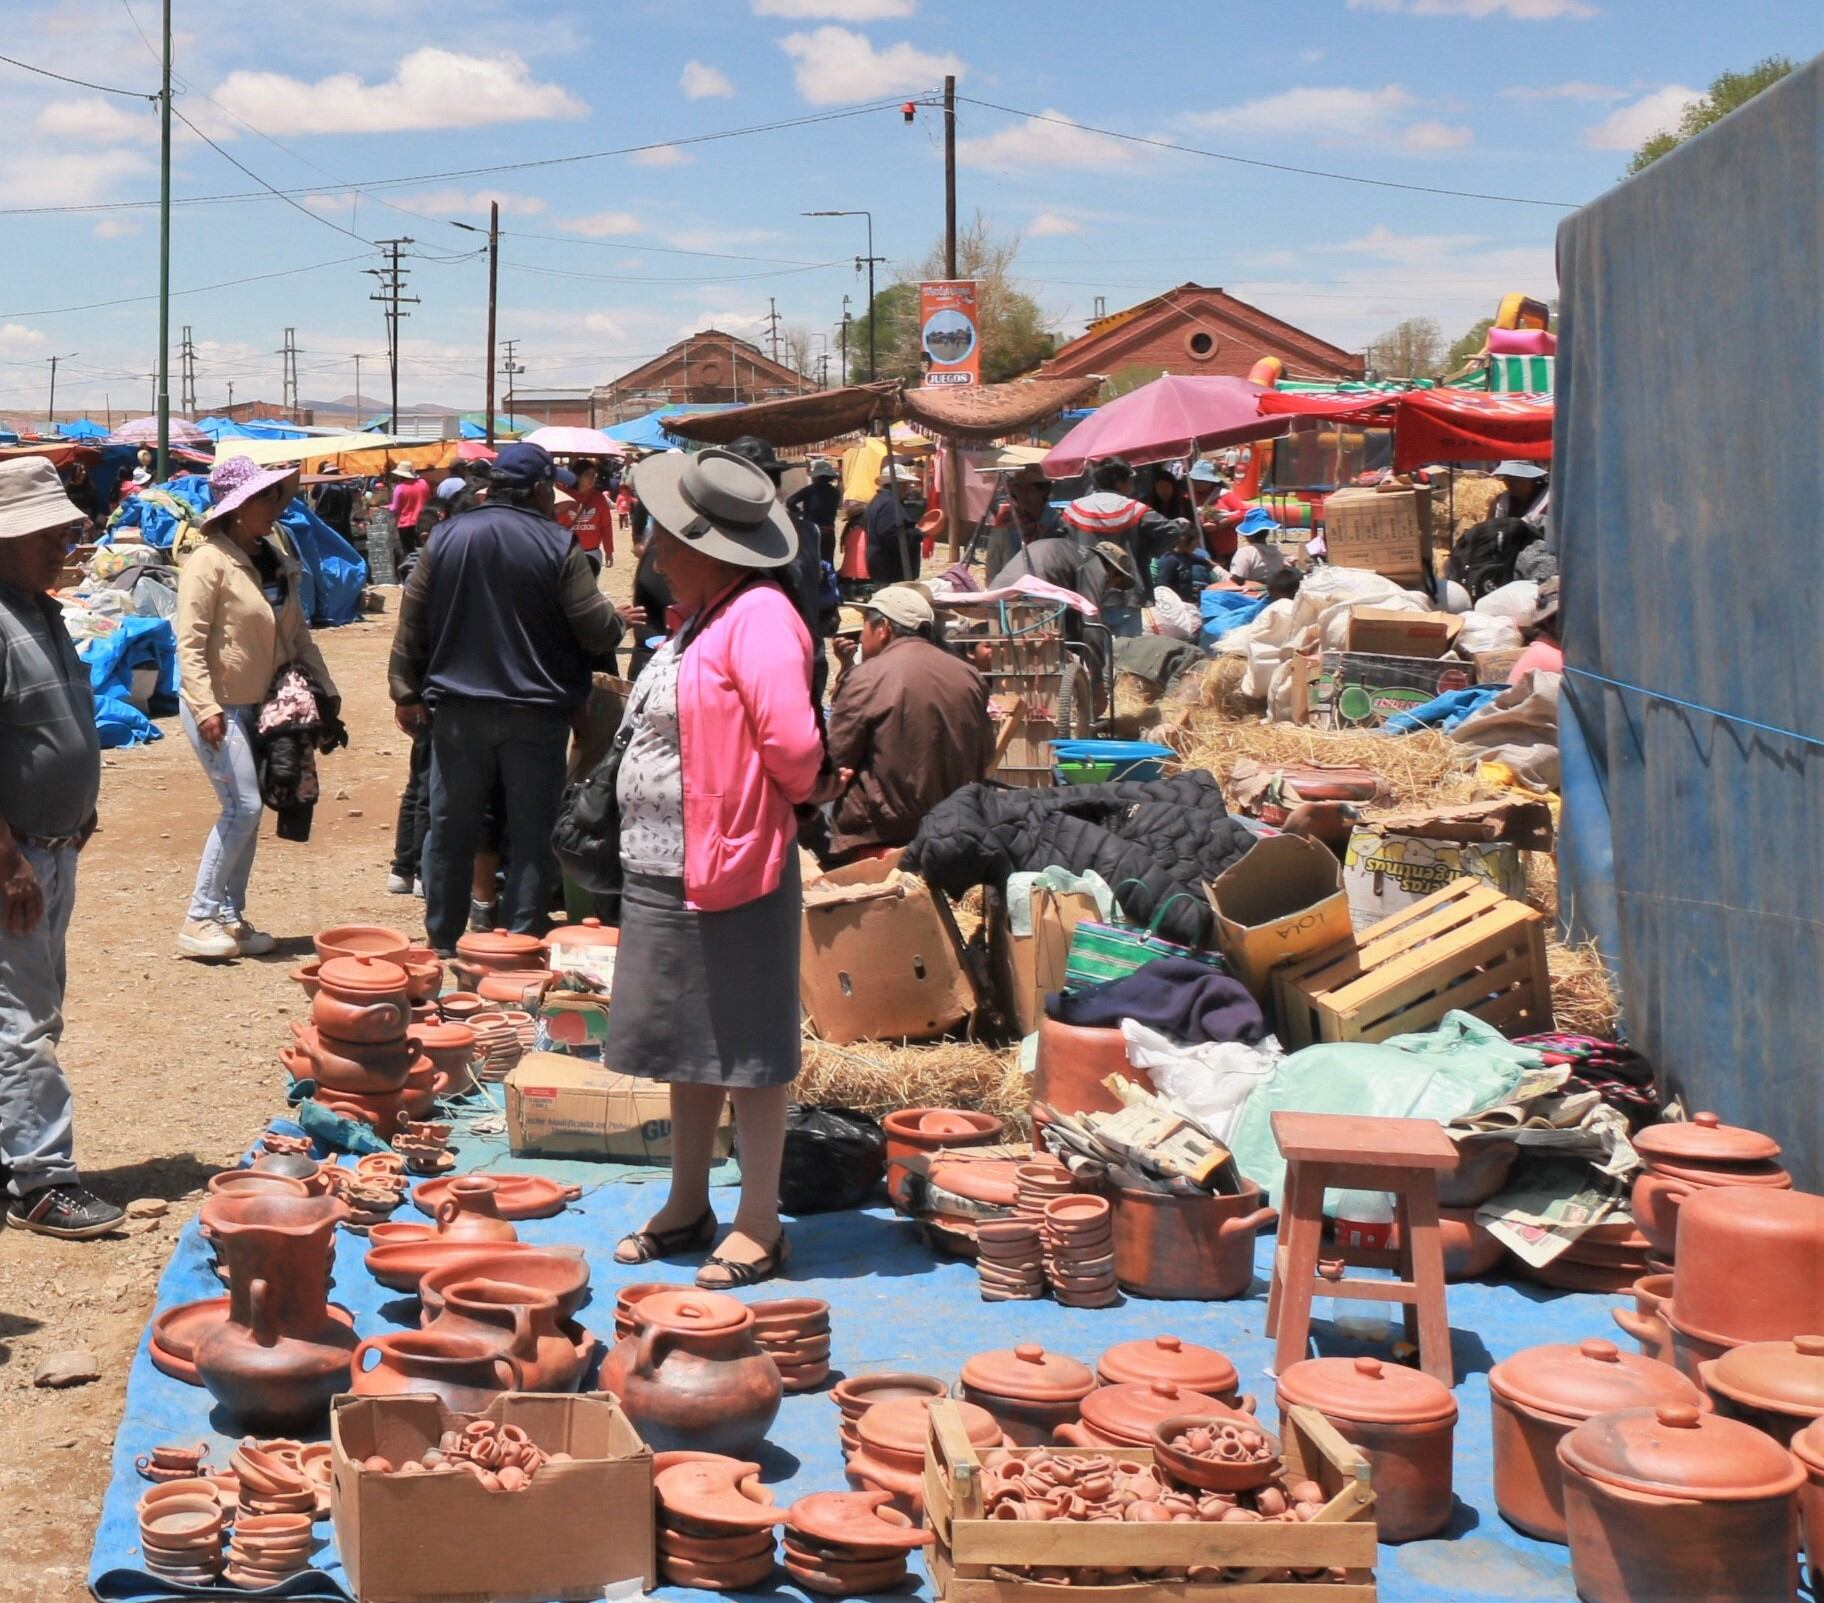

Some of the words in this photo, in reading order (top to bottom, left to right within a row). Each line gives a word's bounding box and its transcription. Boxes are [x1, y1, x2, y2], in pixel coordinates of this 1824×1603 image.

[929, 374, 968, 385] JUEGOS
[1401, 878, 1447, 894] eras
[1275, 912, 1325, 939] LOLA
